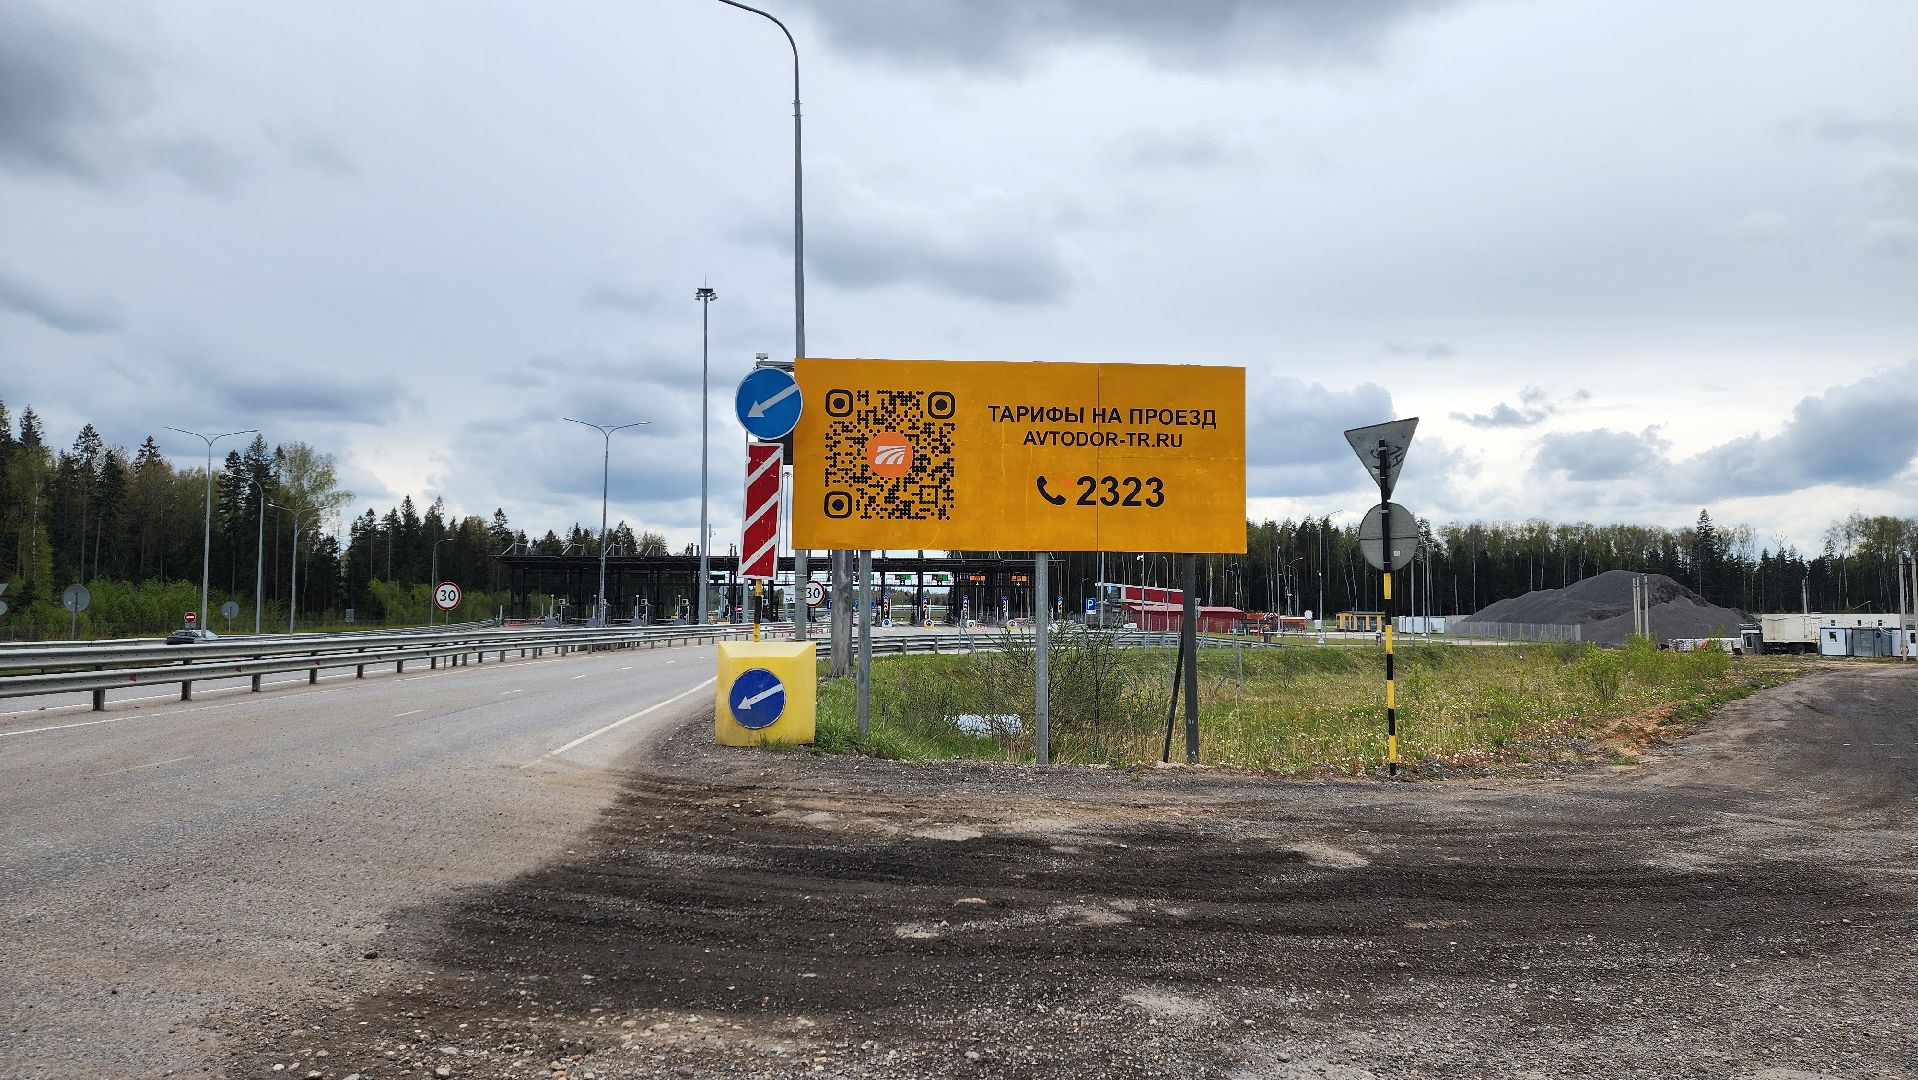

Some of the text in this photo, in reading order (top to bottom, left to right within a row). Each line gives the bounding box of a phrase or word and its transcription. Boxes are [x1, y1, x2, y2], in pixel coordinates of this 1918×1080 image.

[988, 405, 1217, 430] ТАРИФЫ НА ПРОЕЗД
[1023, 430, 1183, 448] AVTODOR-TR.RU
[1076, 475, 1165, 508] 2323
[439, 589, 456, 602] 30
[806, 587, 820, 599] 30
